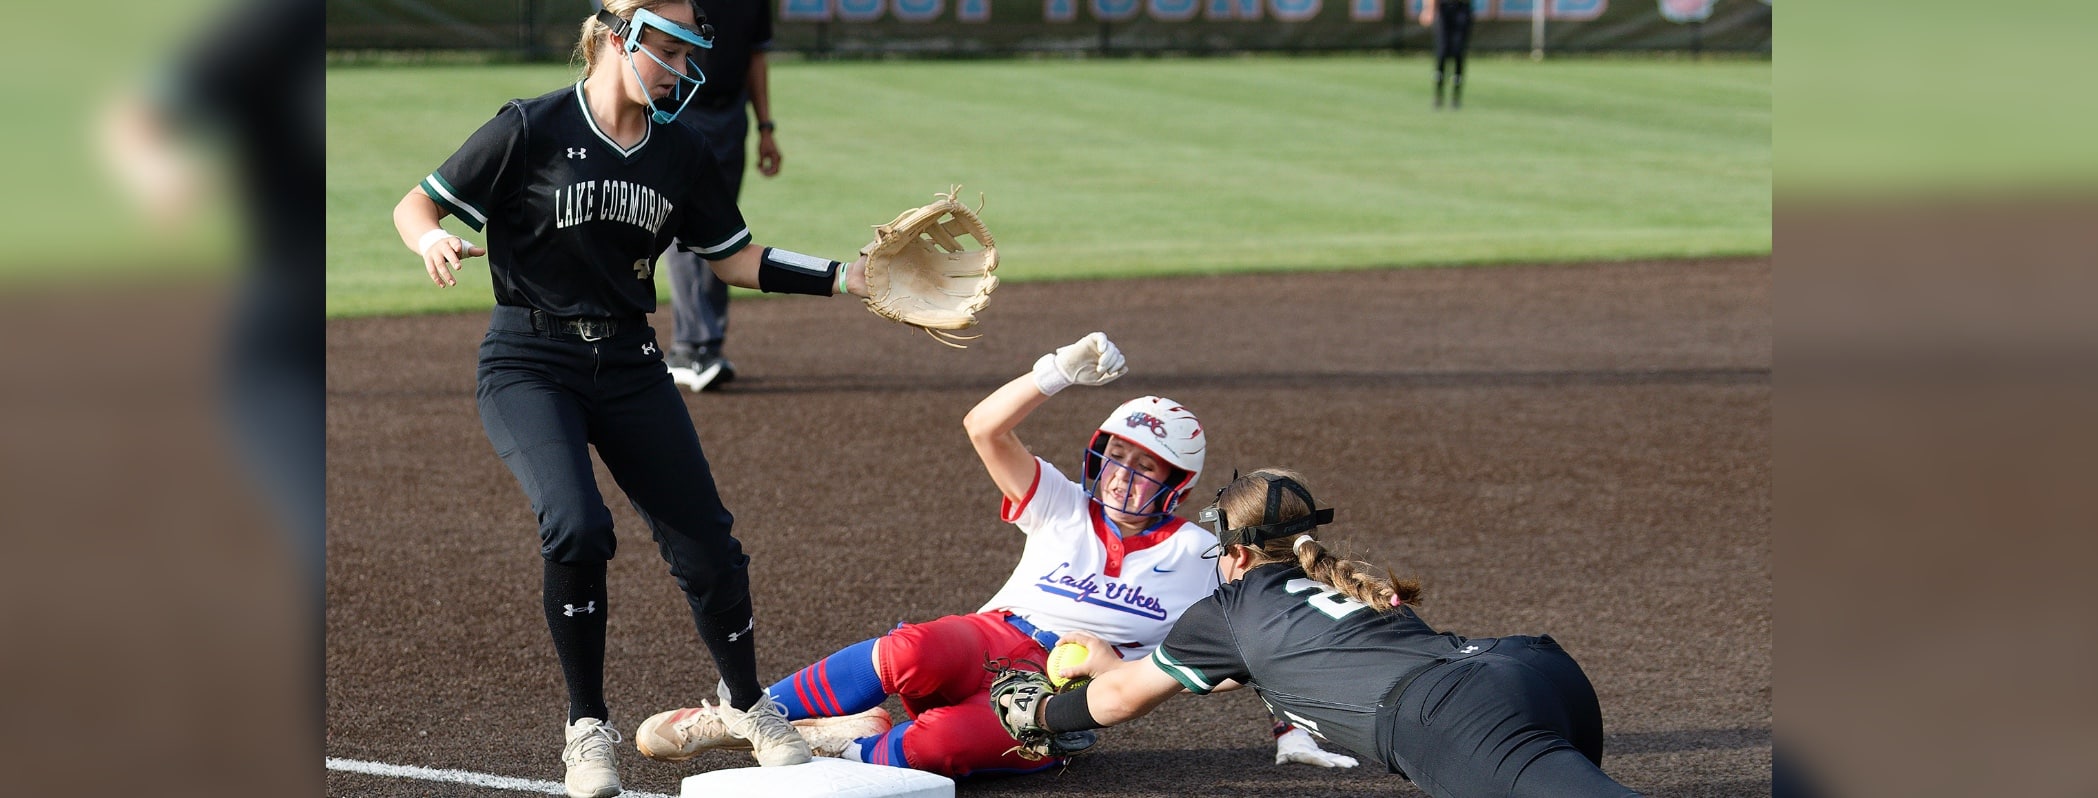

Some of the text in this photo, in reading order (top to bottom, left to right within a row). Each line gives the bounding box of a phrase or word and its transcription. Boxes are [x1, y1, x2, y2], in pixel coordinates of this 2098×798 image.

[555, 180, 596, 229] LAKE
[1039, 562, 1165, 614] Lady Vikes
